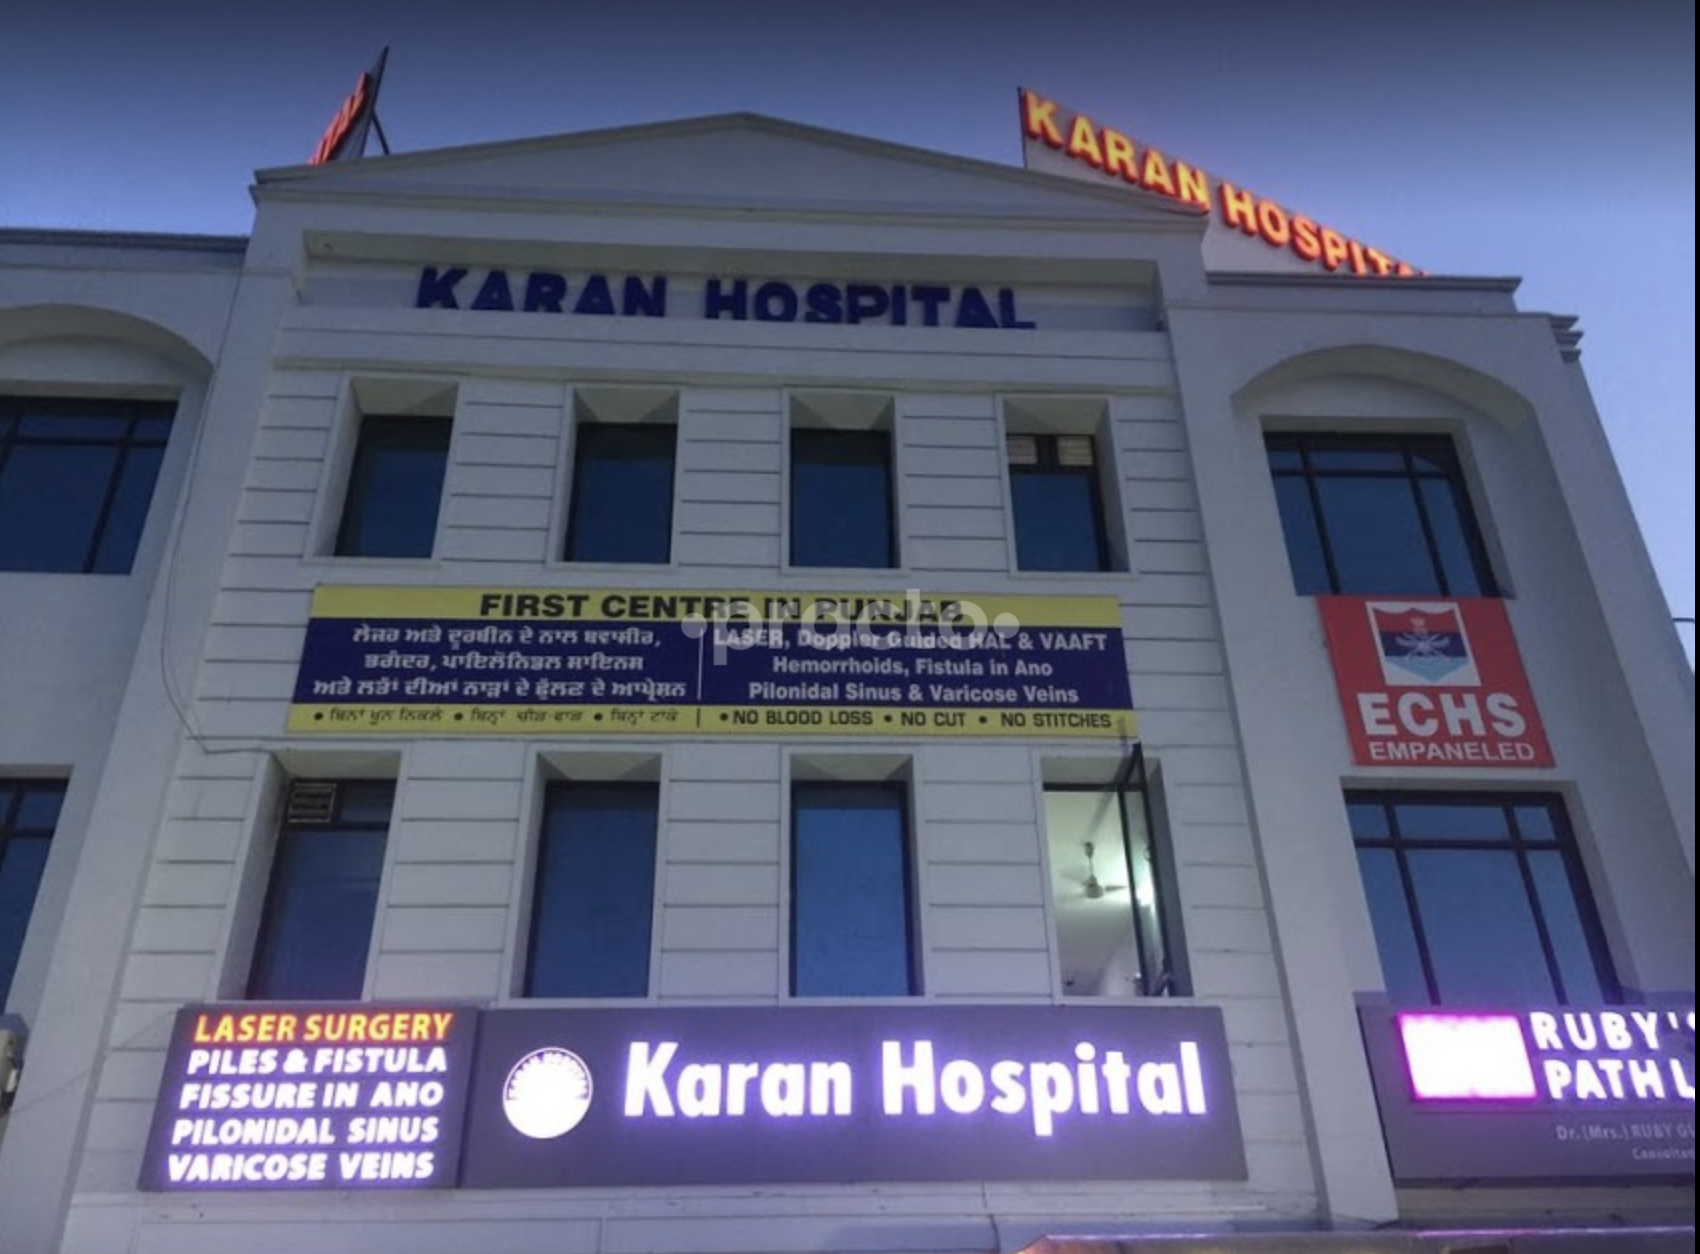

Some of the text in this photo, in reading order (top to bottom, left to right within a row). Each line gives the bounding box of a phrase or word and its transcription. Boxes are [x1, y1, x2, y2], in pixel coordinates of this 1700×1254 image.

[1023, 90, 1211, 214] KARAN
[415, 267, 1037, 330] KARAN HOSPITAL
[480, 594, 964, 622] FIRST CENTRE IN PUNJAB
[713, 629, 1108, 651] LASER, Doppler Guided HAL & VAAFT
[773, 655, 1054, 678] Hemorrhoids, Fistula in Ano
[749, 681, 1079, 703] Pilonidal Sinus & Varicose Veins
[733, 710, 1112, 728] NO BLOOD LOSS NO CUT NO STITCHES
[1356, 691, 1527, 737] ECHS
[1368, 741, 1535, 761] EMPANELED
[194, 1012, 453, 1043] LASER SURGERY
[187, 1047, 447, 1075] PILES & FISTULA
[179, 1081, 444, 1109] FISSURE IN ANO
[624, 1041, 852, 1117] Karan
[881, 1040, 1207, 1136] Hospital
[171, 1116, 440, 1146] PILONIDAL SINUS
[1631, 1122, 1673, 1139] RUBY
[167, 1152, 434, 1182] VARICOSE VEINS
